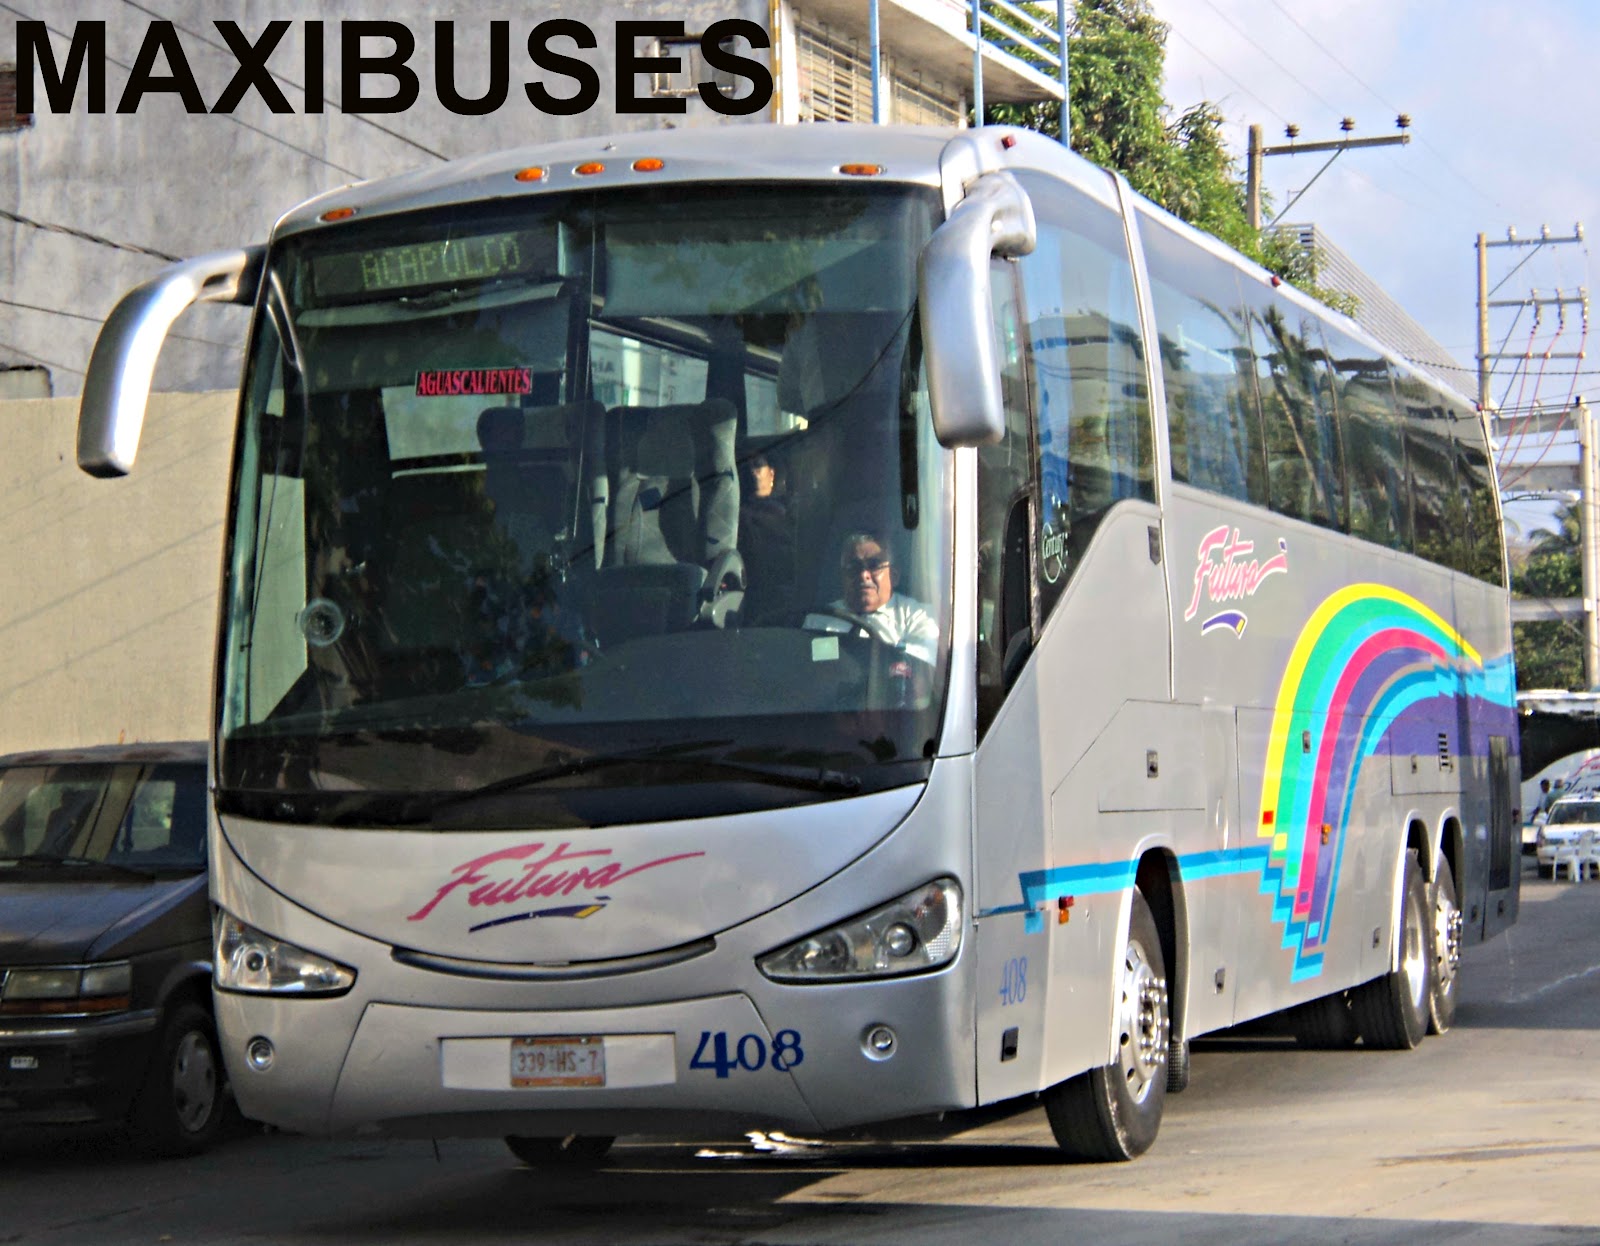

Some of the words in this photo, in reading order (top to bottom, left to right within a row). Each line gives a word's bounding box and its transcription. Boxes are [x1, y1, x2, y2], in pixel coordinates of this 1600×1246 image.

[361, 237, 521, 288] ACAPULCO
[417, 368, 531, 396] AGUASCALIENTES
[1184, 525, 1288, 621] Futura
[406, 842, 705, 921] Futura
[998, 956, 1028, 1006] 408
[689, 1029, 804, 1078] 408
